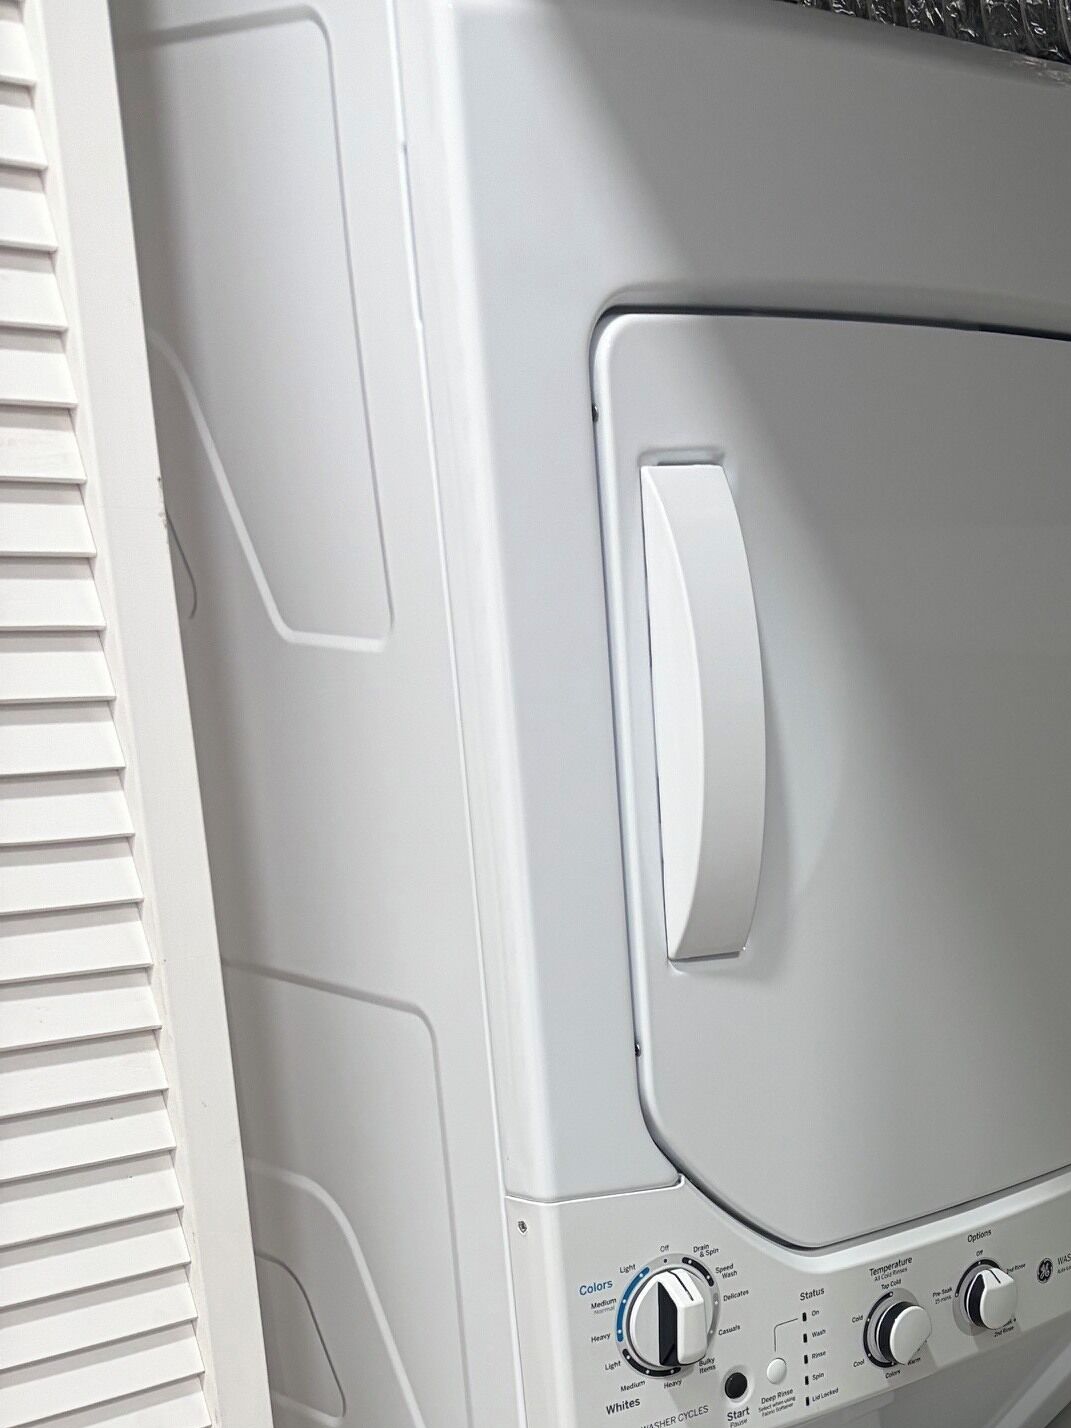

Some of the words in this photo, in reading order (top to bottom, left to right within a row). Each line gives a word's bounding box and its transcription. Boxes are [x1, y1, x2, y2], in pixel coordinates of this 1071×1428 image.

[967, 1229, 992, 1243] Options
[693, 1244, 710, 1253] Drain
[705, 1247, 719, 1256] Spin
[620, 1264, 636, 1274] Light
[715, 1263, 734, 1274] Speed
[869, 1257, 912, 1276] Temperature
[721, 1270, 738, 1279] Wash
[579, 1280, 613, 1296] Colors
[890, 1278, 901, 1287] Cold
[723, 1289, 749, 1302] Delicates
[800, 1287, 825, 1301] Status
[591, 1298, 617, 1310] Medium
[851, 1314, 864, 1323] Cold
[718, 1324, 741, 1336] Casuals
[811, 1329, 826, 1338] Wash
[591, 1332, 611, 1343] Heavy
[811, 1350, 827, 1360] Rinse
[604, 1360, 621, 1371] Light
[699, 1357, 715, 1367] Bulky
[853, 1359, 865, 1368] Cool
[699, 1364, 716, 1374] Items
[885, 1370, 901, 1379] Colors
[812, 1372, 825, 1381] Spin
[620, 1379, 646, 1392] Medium
[663, 1379, 682, 1389] Heavy
[761, 1394, 777, 1405] Deep
[777, 1388, 794, 1399] Rinse
[820, 1387, 839, 1399] Locked
[605, 1398, 641, 1415] Whites
[677, 1404, 709, 1422] CYCLES
[727, 1407, 750, 1421] Start
[730, 1418, 748, 1428] Pause
